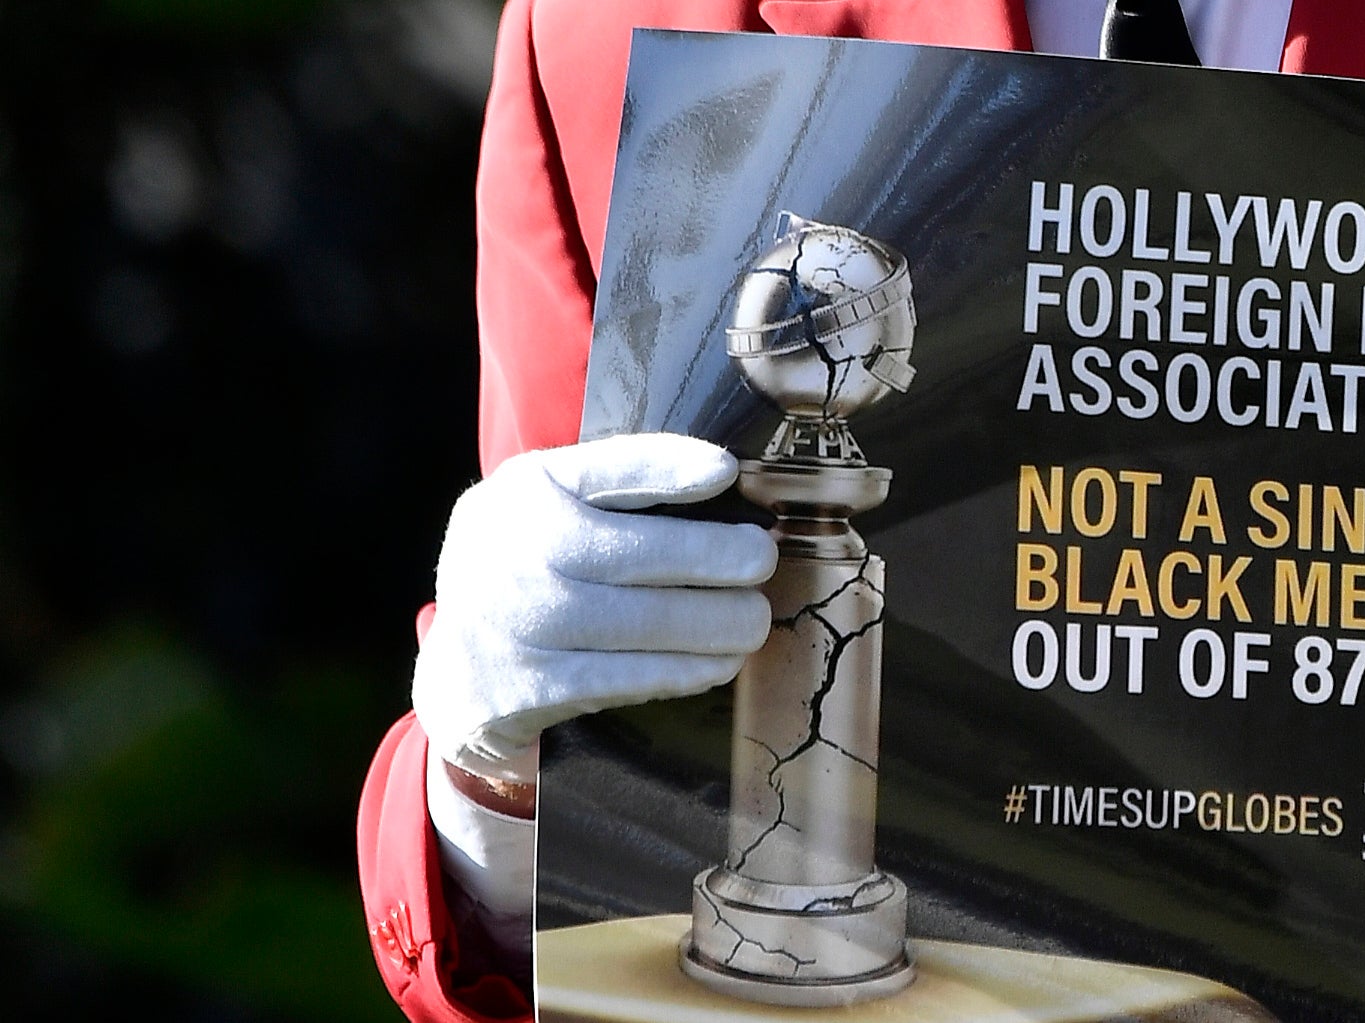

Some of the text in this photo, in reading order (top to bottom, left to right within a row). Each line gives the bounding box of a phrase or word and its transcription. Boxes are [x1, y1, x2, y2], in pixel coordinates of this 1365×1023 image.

[1023, 262, 1335, 353] FOREIGN
[1018, 465, 1162, 539] NOT
[1178, 476, 1227, 545] A
[1015, 542, 1253, 623] BLACK
[1012, 619, 1159, 694] OUT
[1178, 628, 1271, 699] OF
[1004, 784, 1344, 837] #TIMESUPGLOBES
